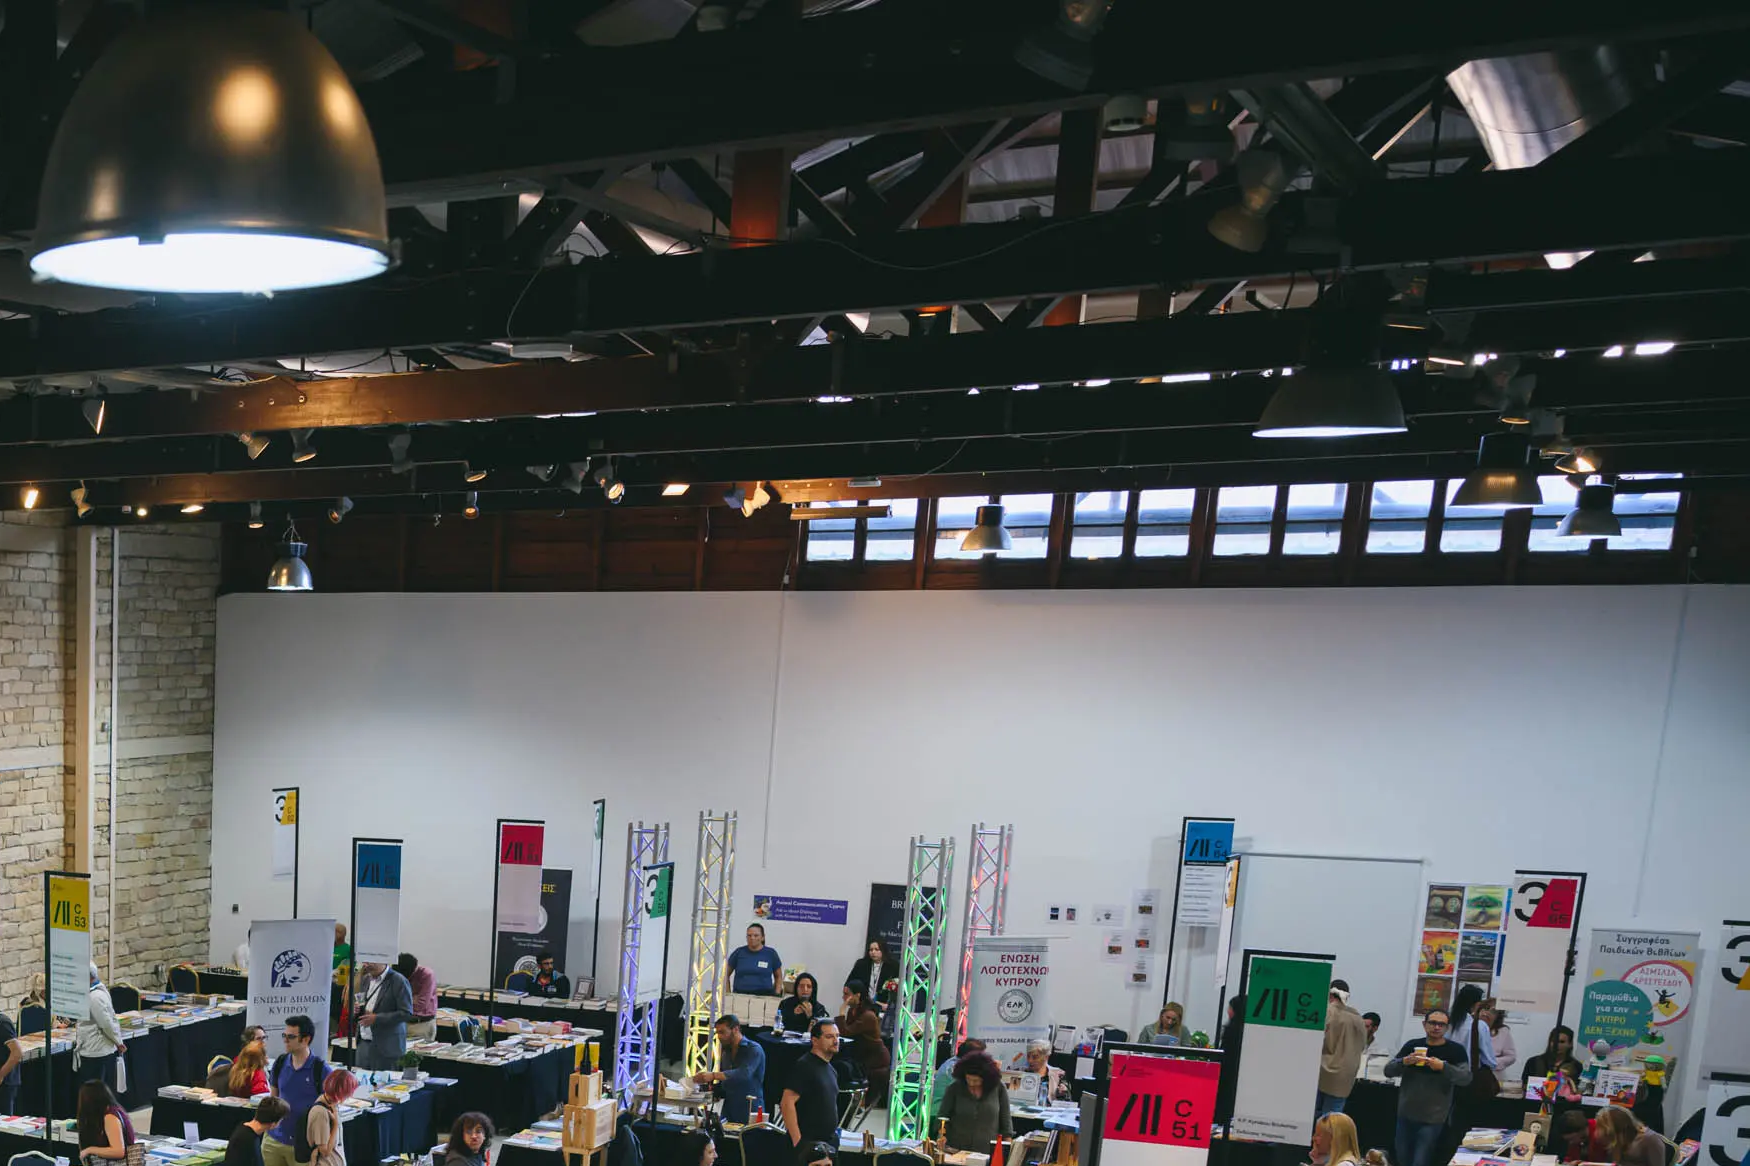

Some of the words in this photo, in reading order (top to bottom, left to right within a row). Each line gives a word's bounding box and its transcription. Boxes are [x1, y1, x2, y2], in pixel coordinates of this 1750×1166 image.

[1514, 881, 1549, 922] 3
[74, 904, 81, 914] C
[74, 916, 87, 928] 53
[1000, 954, 1040, 964] ΕΝΩΣΗ
[995, 978, 1041, 987] ΚΥΠΡΟΥ
[254, 995, 287, 1004] ΕΝΩΣΗ
[1297, 992, 1312, 1007] C
[269, 1006, 309, 1015] ΚΥΠΡΟΥ
[1296, 1008, 1319, 1025] 54
[1174, 1099, 1193, 1118] C
[1172, 1120, 1203, 1141] 51
